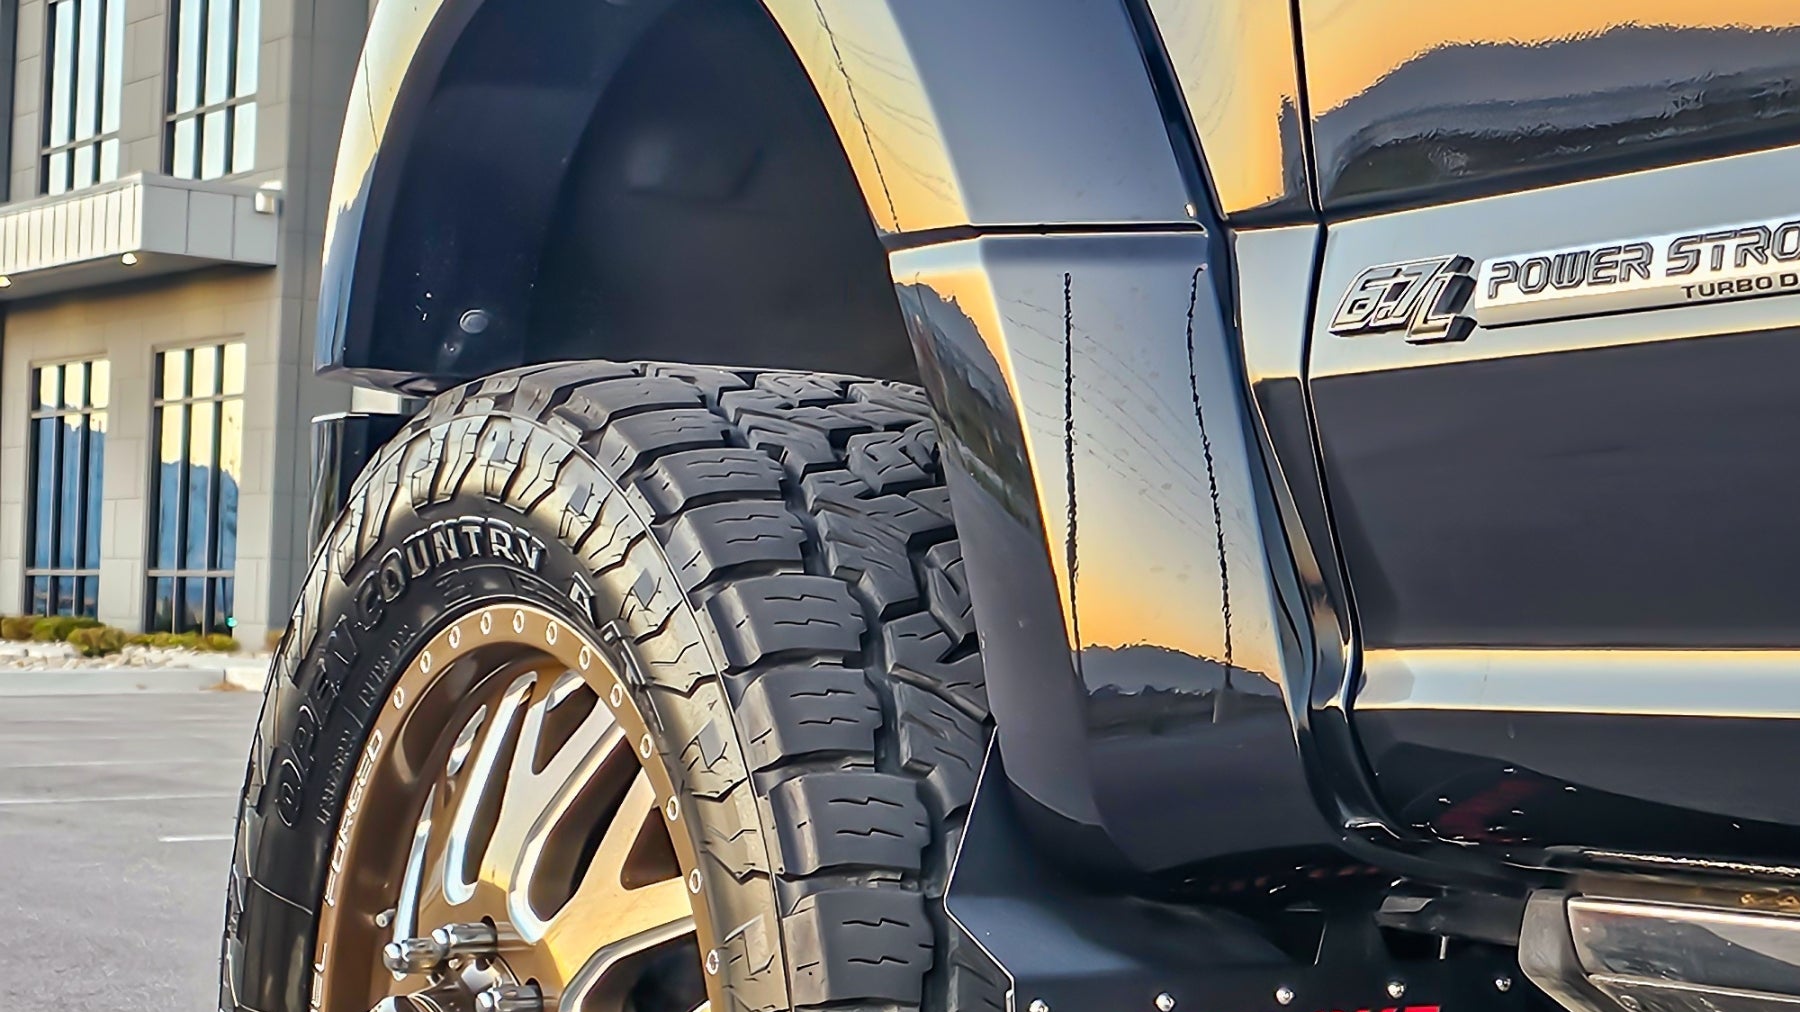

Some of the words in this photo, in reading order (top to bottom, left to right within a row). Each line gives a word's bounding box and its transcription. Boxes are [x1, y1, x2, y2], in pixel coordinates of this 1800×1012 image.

[1487, 242, 1653, 300] POWER
[1680, 274, 1774, 302] TURBO
[353, 515, 552, 632] COUNTRY
